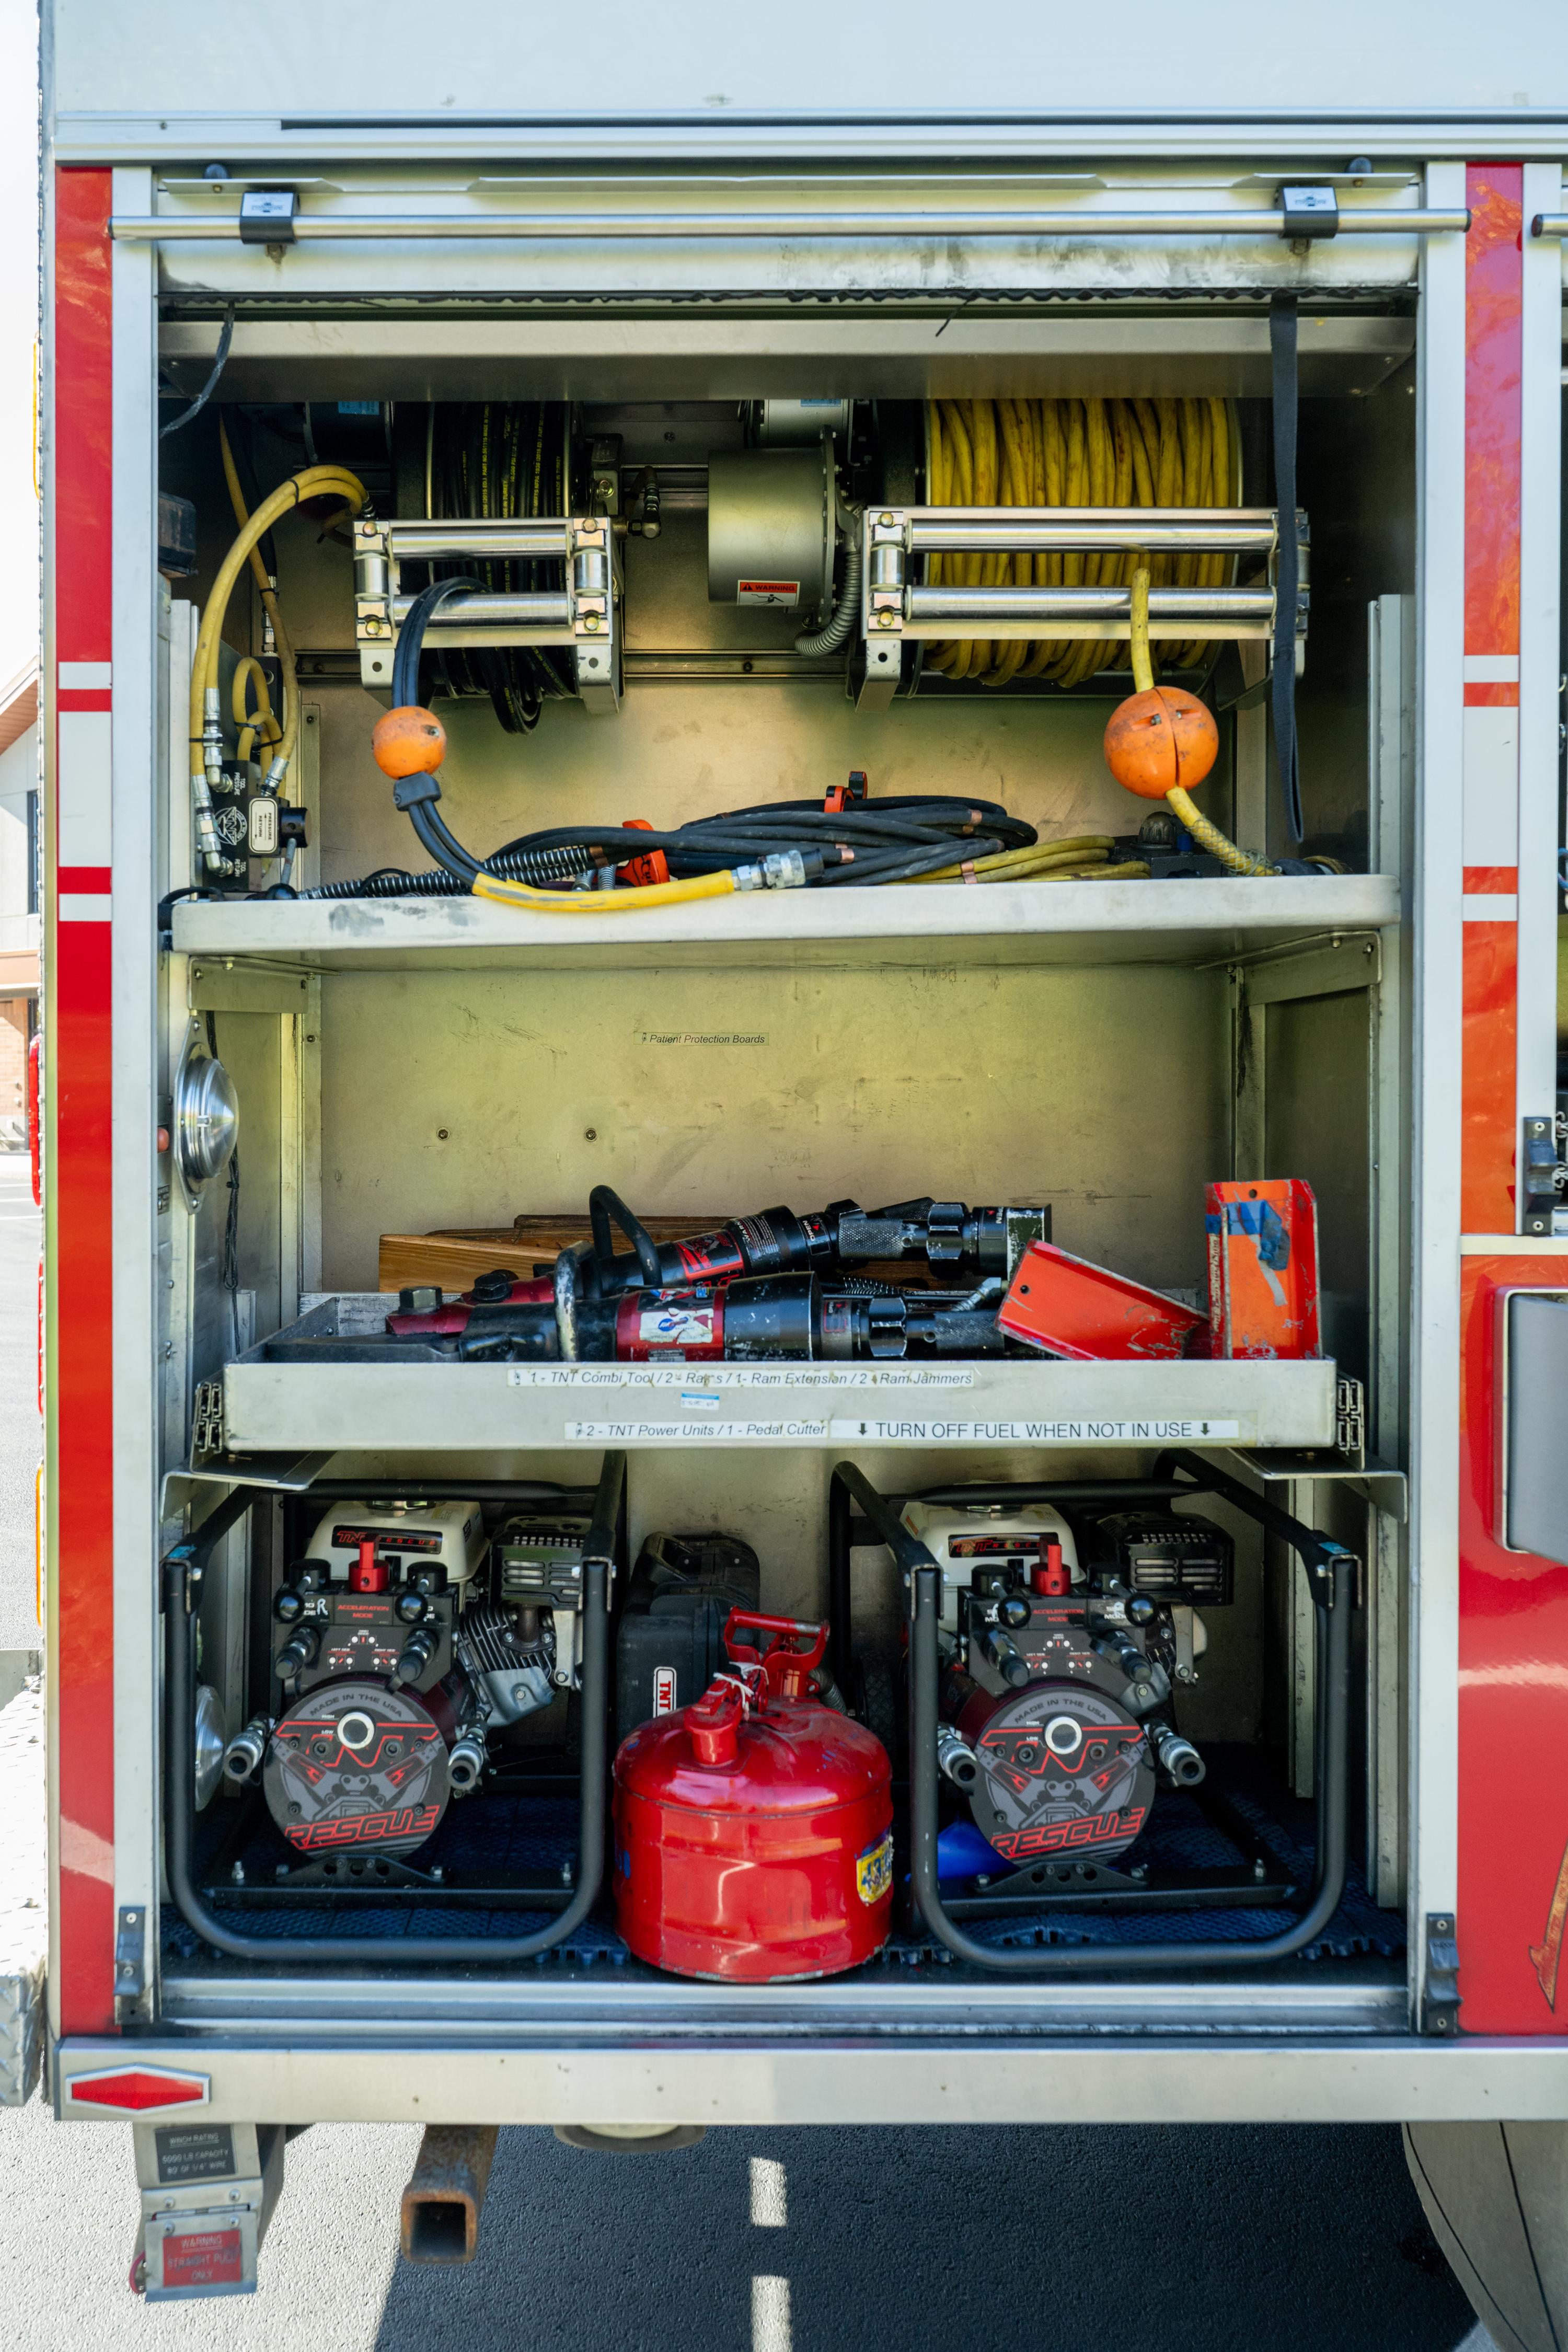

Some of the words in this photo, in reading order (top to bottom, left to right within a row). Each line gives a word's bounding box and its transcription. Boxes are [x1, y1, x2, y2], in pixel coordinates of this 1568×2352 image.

[650, 1034, 682, 1044] Patient
[684, 1035, 730, 1044] Protection
[733, 1034, 765, 1044] Boards
[802, 1220, 815, 1242] OPEN
[531, 1373, 536, 1383] 1
[551, 1371, 579, 1383] TNT
[582, 1371, 622, 1383] Combi
[627, 1372, 654, 1383] Tool
[665, 1373, 673, 1383] 2
[752, 1373, 781, 1384] Ram
[785, 1373, 847, 1385] Extension
[860, 1374, 868, 1385] 2
[880, 1374, 909, 1385] Ram
[914, 1373, 972, 1385] Jammers
[587, 1425, 595, 1436] 2
[608, 1425, 636, 1436] TNT
[639, 1424, 679, 1436] Power
[683, 1424, 714, 1436] Units
[718, 1425, 724, 1436] /
[727, 1425, 733, 1435] 1
[746, 1424, 783, 1436] Pedal
[787, 1423, 827, 1435] Cutter
[875, 1422, 926, 1437] TURN
[932, 1423, 969, 1438] OFF
[974, 1423, 1020, 1438] FUEL
[1025, 1423, 1081, 1438] WHEN
[1088, 1423, 1126, 1437] NOT
[1132, 1423, 1149, 1437] IN
[1155, 1422, 1192, 1437] USE
[377, 1536, 436, 1546] ESCUE
[317, 1598, 328, 1616] R
[660, 1680, 672, 1711] TNT
[310, 1696, 340, 1716] MADE
[343, 1693, 355, 1701] IN
[358, 1693, 381, 1704] THE
[382, 1700, 403, 1718] USA
[1014, 1702, 1044, 1724] MADE
[1062, 1698, 1085, 1709] THE
[1087, 1704, 1107, 1722] USA
[284, 1804, 441, 1851] RESCUE
[989, 1806, 1146, 1860] RESCUE
[169, 2135, 192, 2145] WINCH
[193, 2132, 219, 2142] RATING
[162, 2153, 182, 2165] 5000
[183, 2152, 194, 2162] LB
[195, 2148, 229, 2160] CAPACITY
[180, 2164, 190, 2174] OF
[209, 2160, 227, 2170] WIRE
[181, 2234, 222, 2249] WARNING
[167, 2254, 211, 2270] STRAIGHT
[213, 2252, 236, 2265] PULL
[191, 2269, 213, 2281] ONLY
